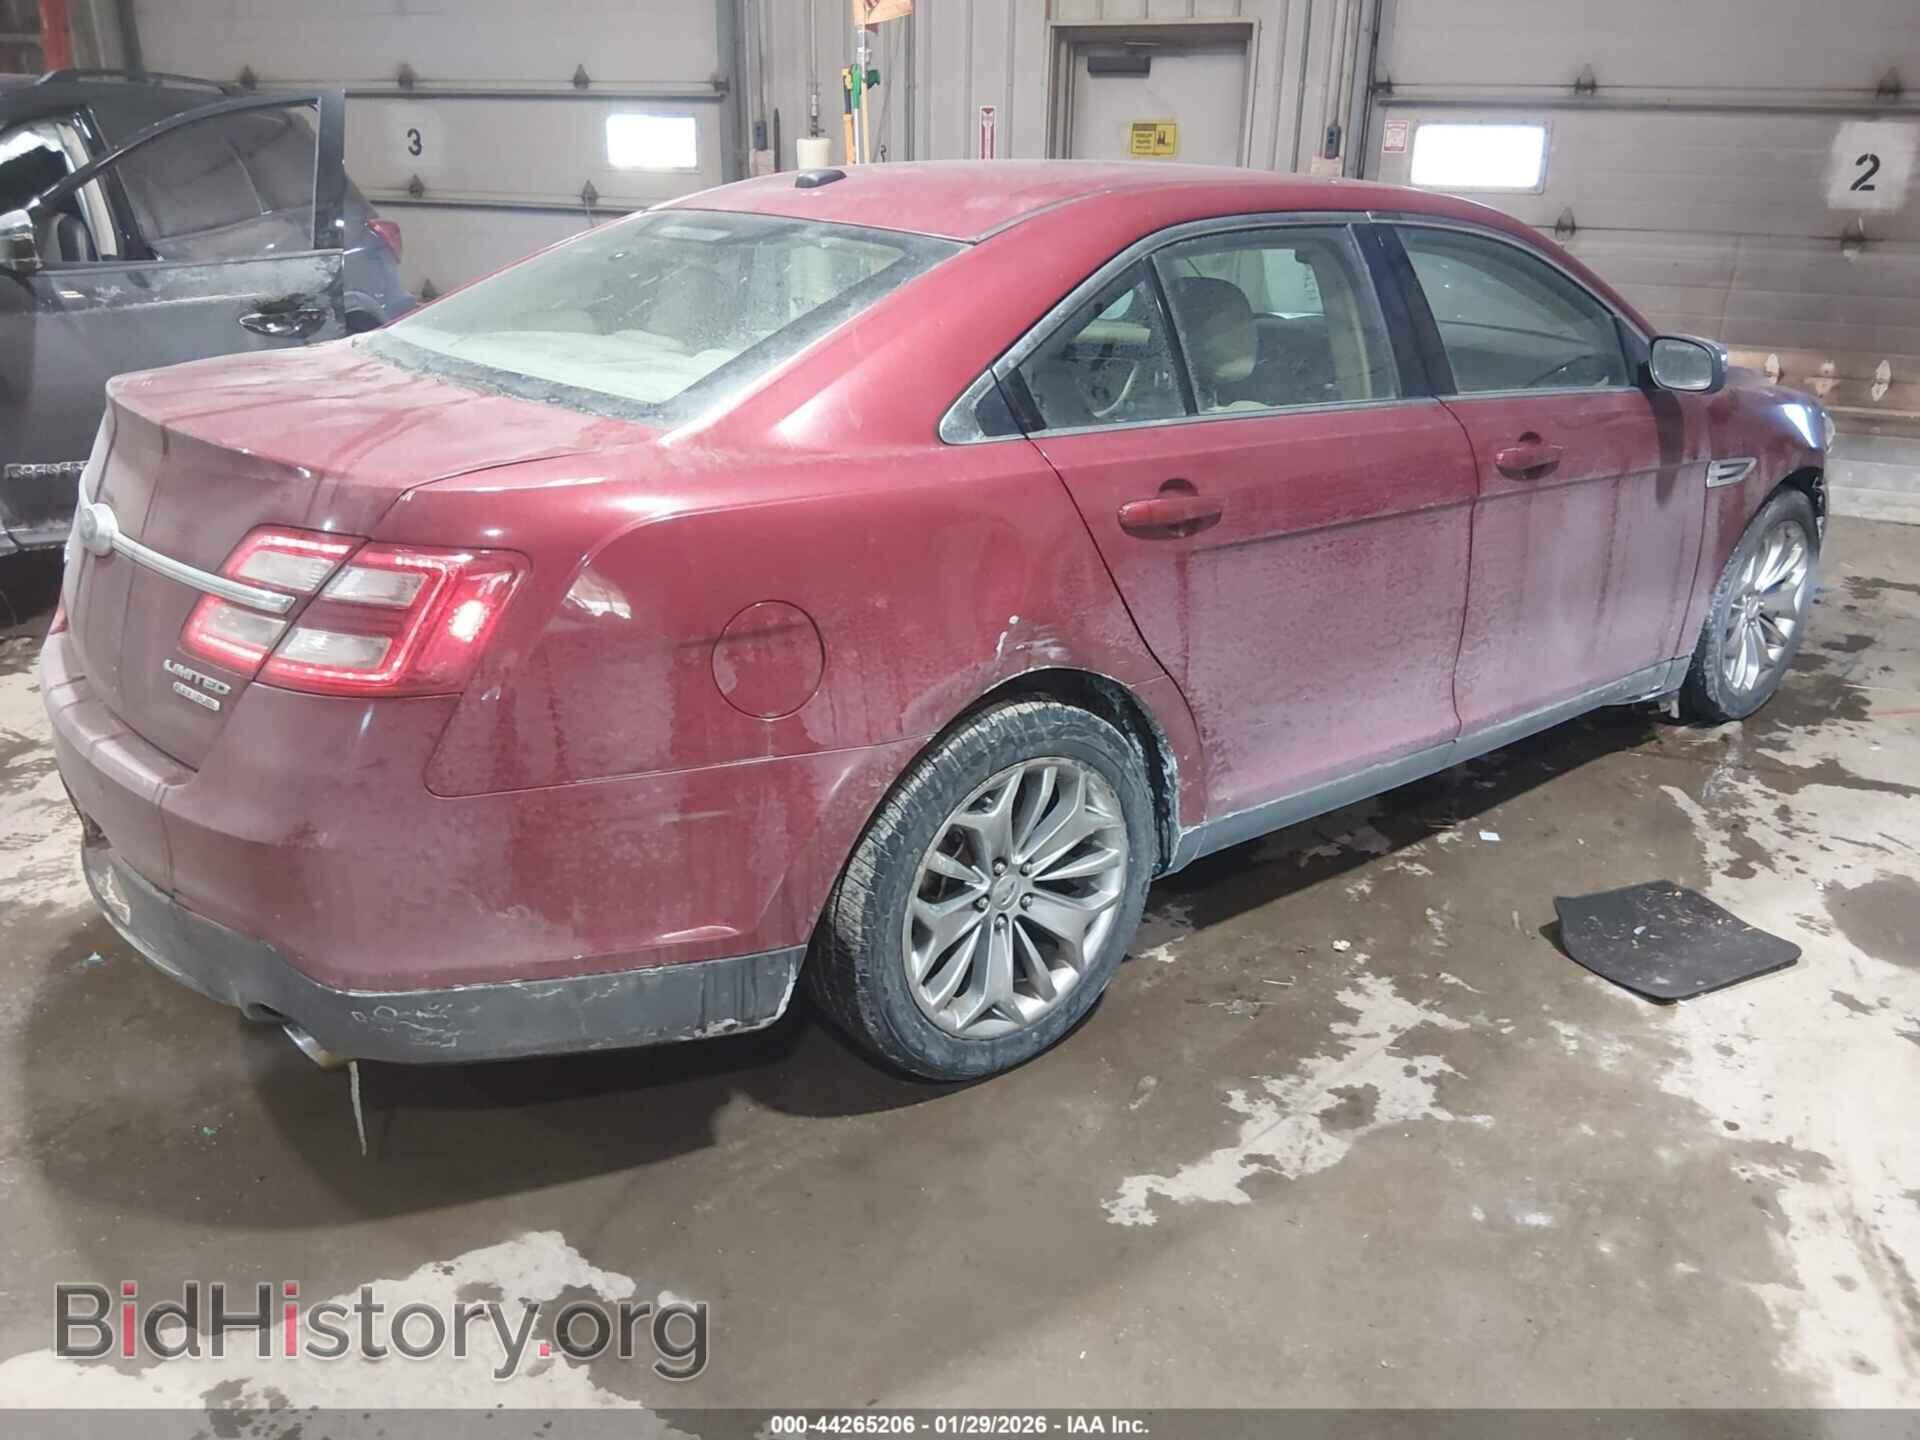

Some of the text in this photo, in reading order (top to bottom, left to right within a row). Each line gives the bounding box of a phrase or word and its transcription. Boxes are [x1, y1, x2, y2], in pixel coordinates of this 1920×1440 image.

[407, 128, 422, 156] 3
[1850, 153, 1880, 191] 2
[163, 659, 231, 695] LIMITED
